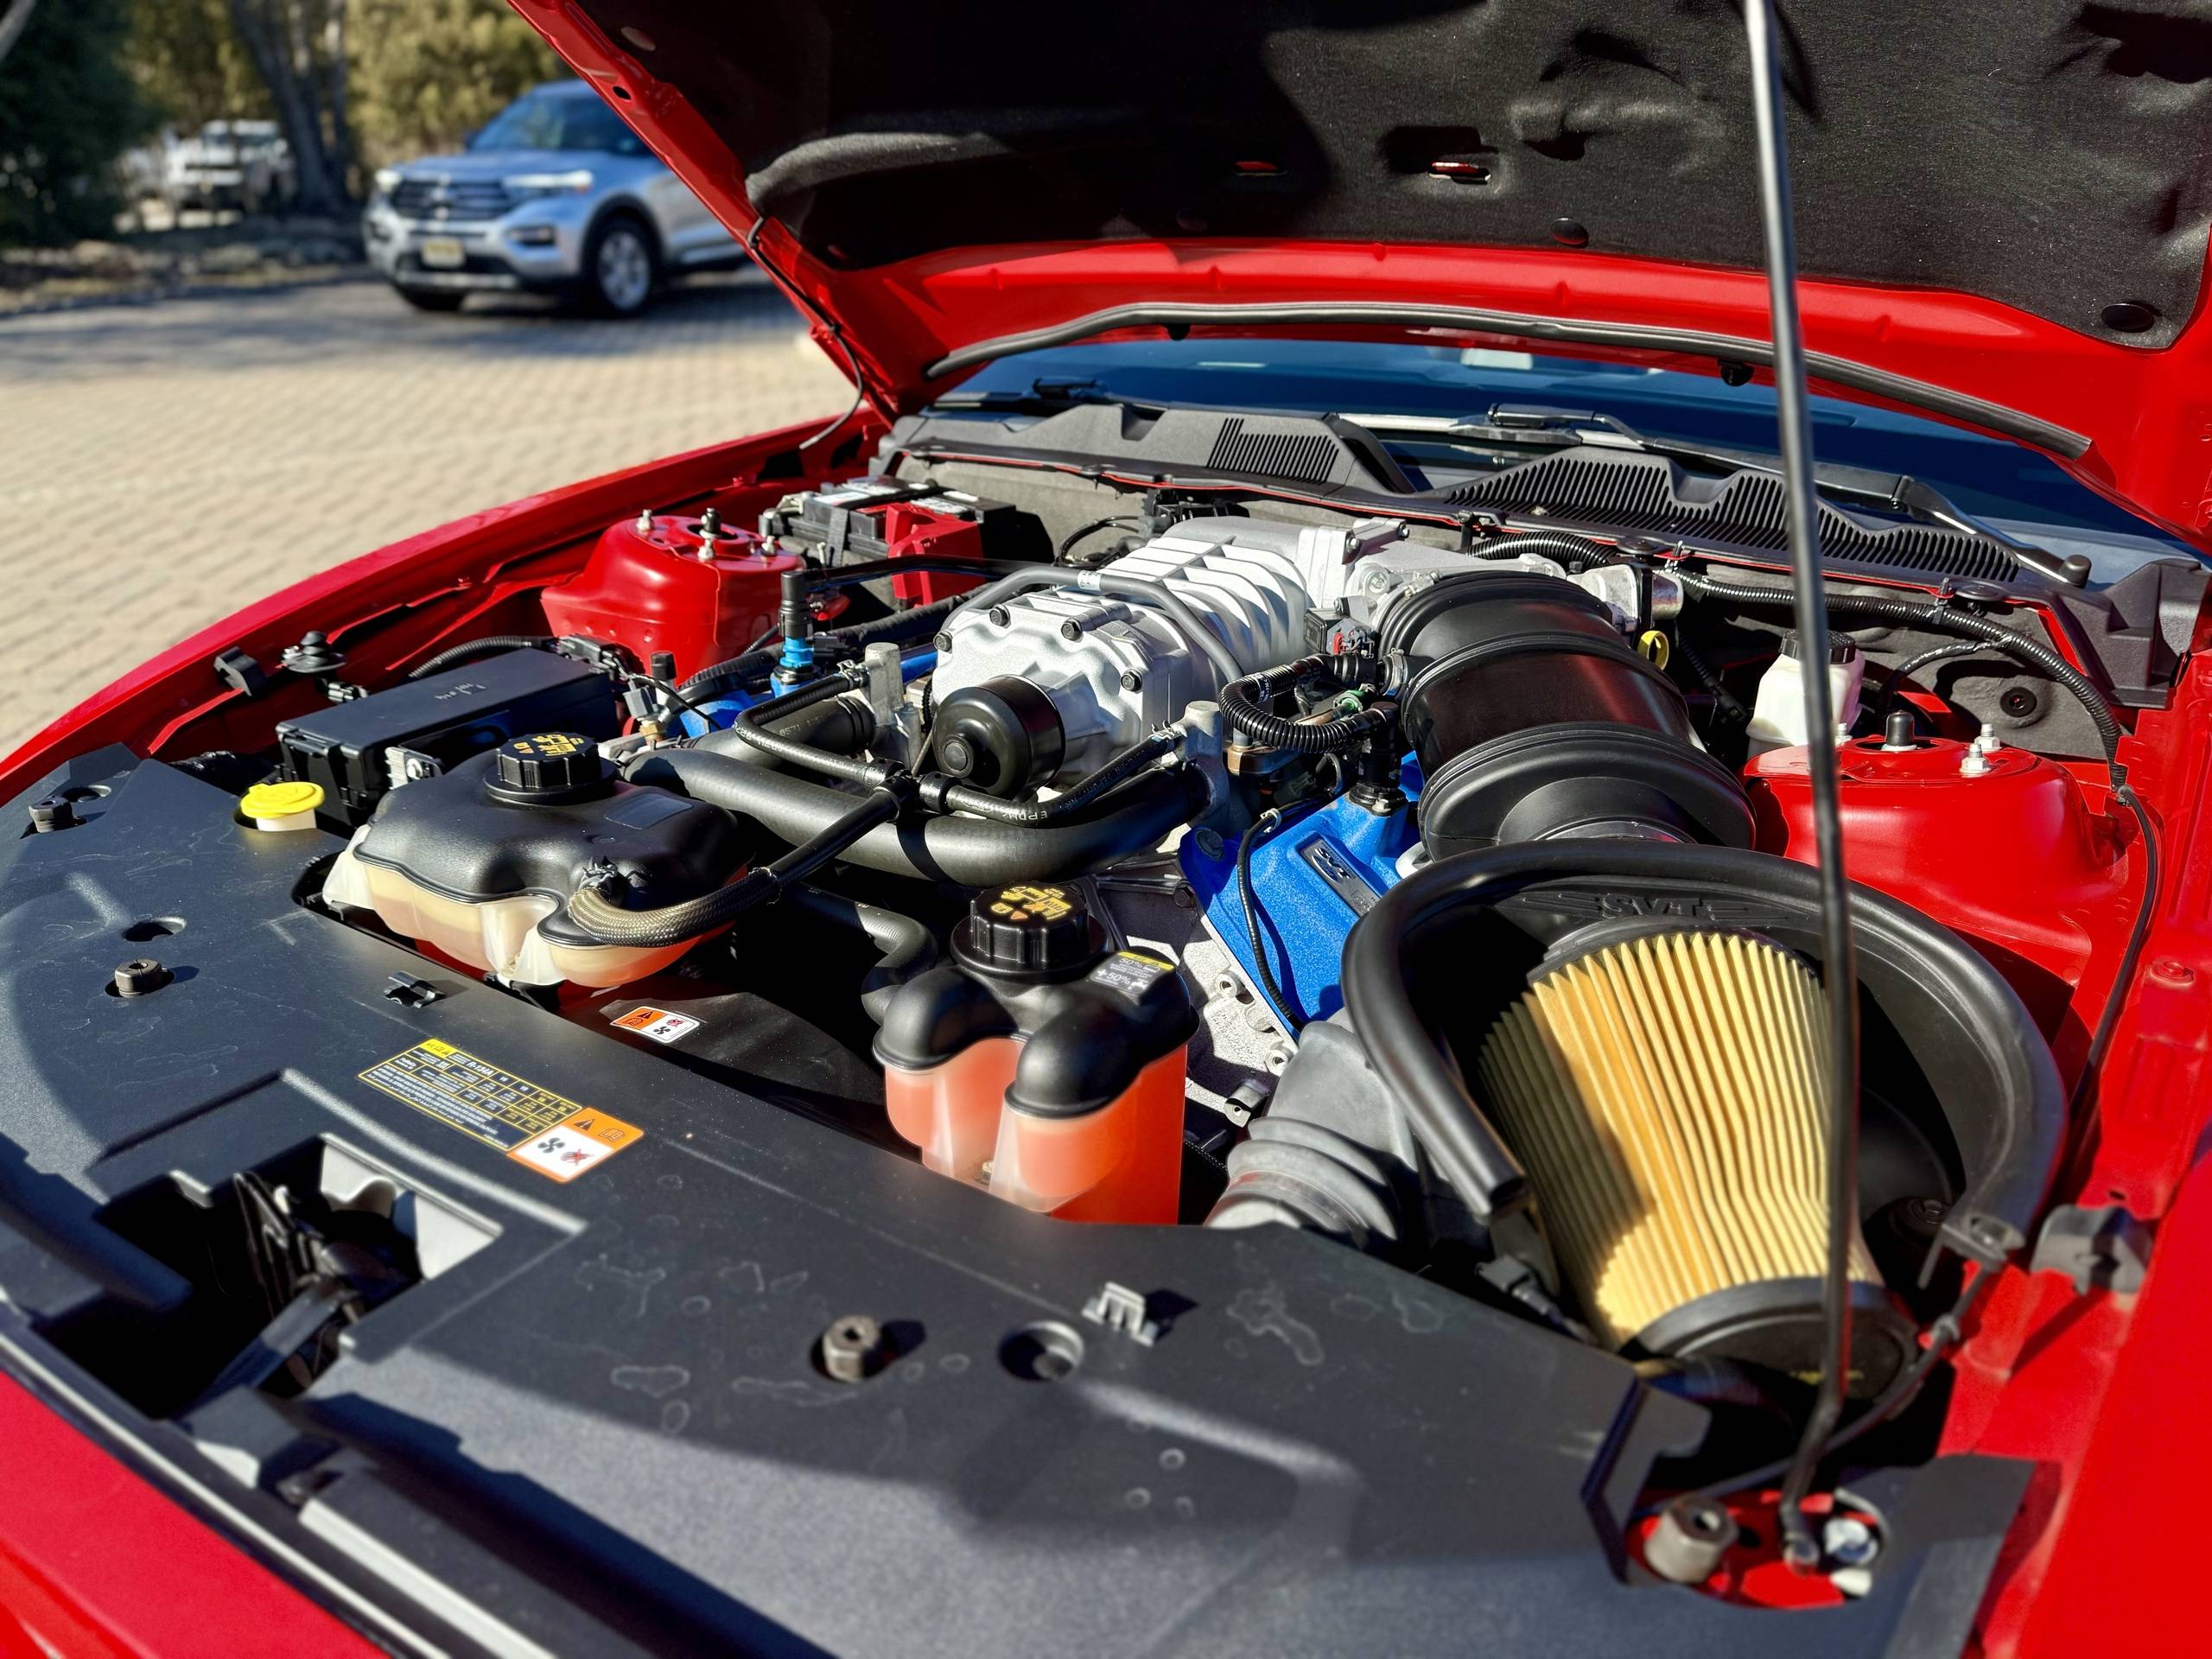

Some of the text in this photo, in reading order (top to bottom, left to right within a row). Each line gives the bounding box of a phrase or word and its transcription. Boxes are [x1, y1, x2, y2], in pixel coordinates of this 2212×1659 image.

[1314, 848, 1351, 879] SVT
[1603, 893, 1703, 919] SVT
[1119, 957, 1143, 969] 50%
[1106, 972, 1132, 984] 50%
